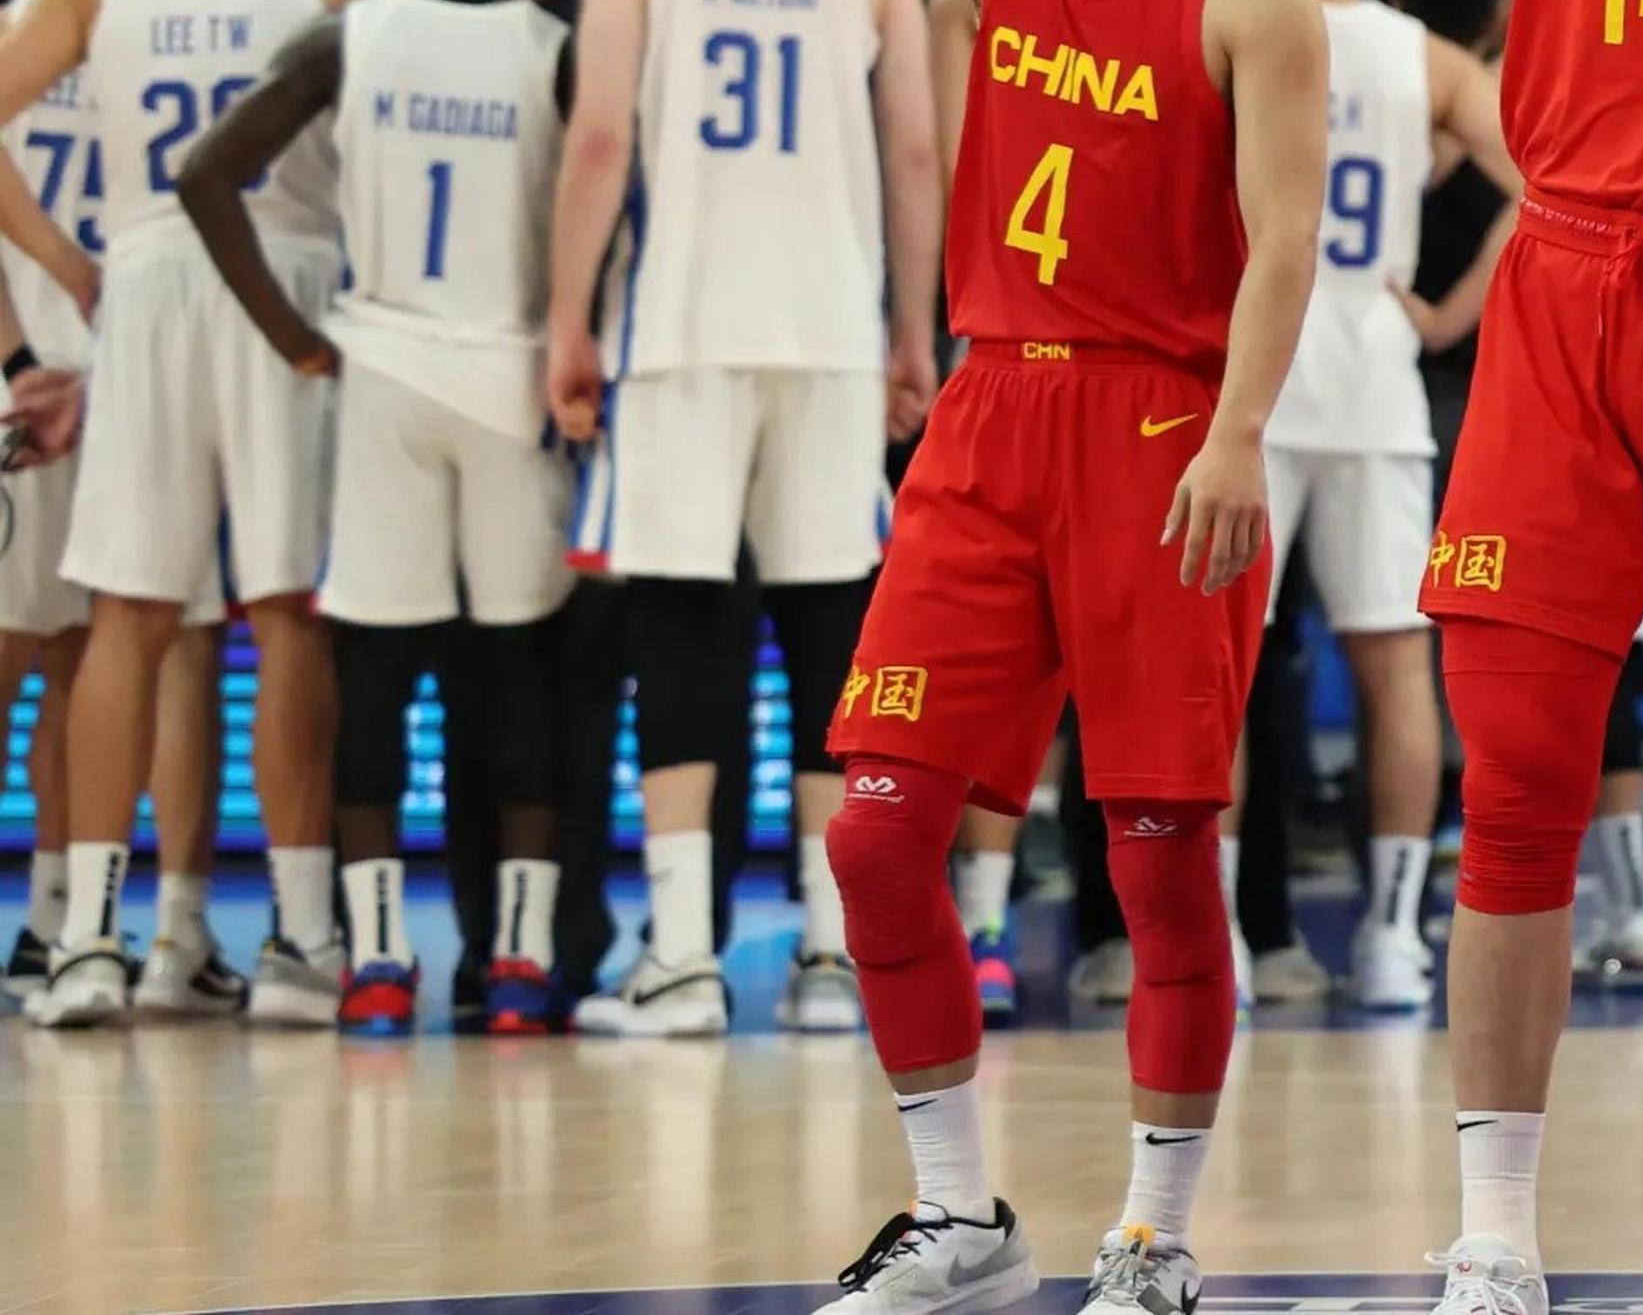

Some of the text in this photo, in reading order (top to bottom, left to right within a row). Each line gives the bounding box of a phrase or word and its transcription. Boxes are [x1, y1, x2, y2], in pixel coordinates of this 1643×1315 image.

[152, 16, 195, 55] LEE
[989, 26, 1159, 121] CHINA
[409, 92, 519, 141] GADIAGA
[700, 31, 801, 152] 31
[423, 161, 454, 280] 1
[1005, 143, 1074, 286] 4
[1326, 157, 1384, 268] 9
[1023, 341, 1071, 361] CHN
[1429, 530, 1507, 592] 中国
[842, 665, 929, 722] 中国
